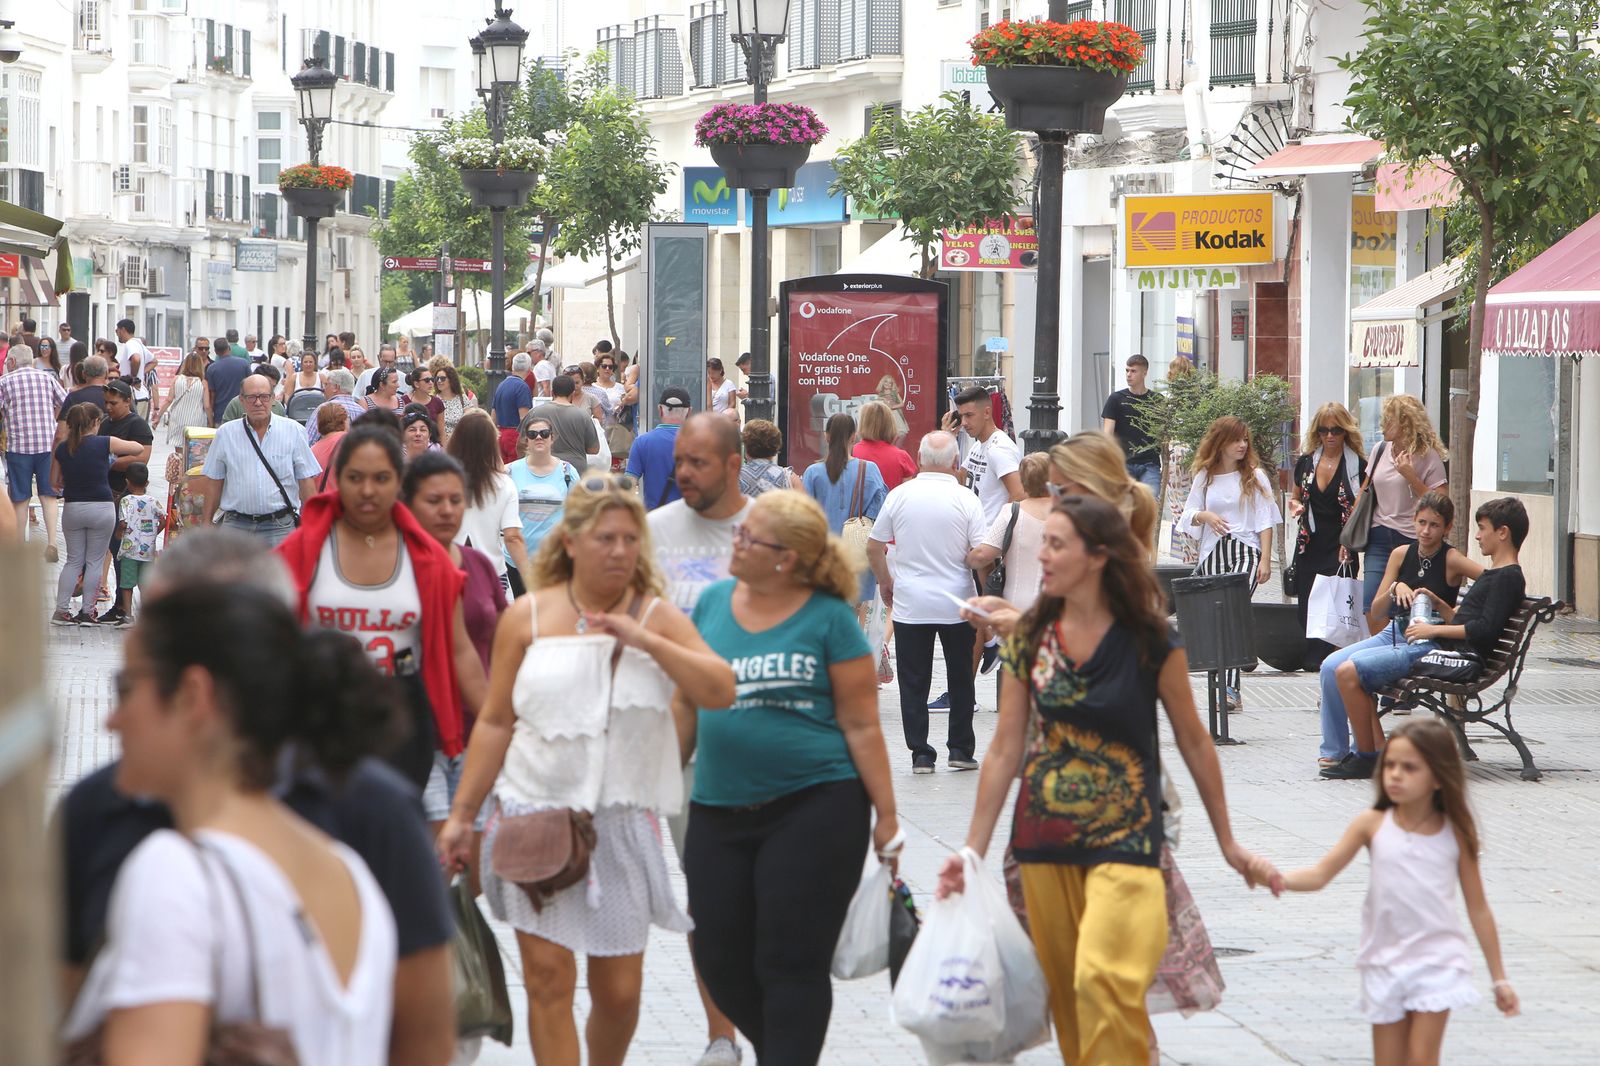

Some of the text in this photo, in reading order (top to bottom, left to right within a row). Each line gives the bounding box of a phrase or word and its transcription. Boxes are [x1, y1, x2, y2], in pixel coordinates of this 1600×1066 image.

[692, 206, 730, 215] movistar
[1181, 208, 1263, 225] PRODUCTOS
[1014, 228, 1036, 236] SUER
[1195, 229, 1266, 250] Kodak
[1137, 268, 1224, 290] MIJITA
[1495, 308, 1570, 349] CALZADOS
[799, 352, 869, 362] Vodafone One.
[799, 364, 871, 375] TV gratis 1 año
[317, 606, 417, 632] BULLS
[731, 652, 817, 681] NGELES
